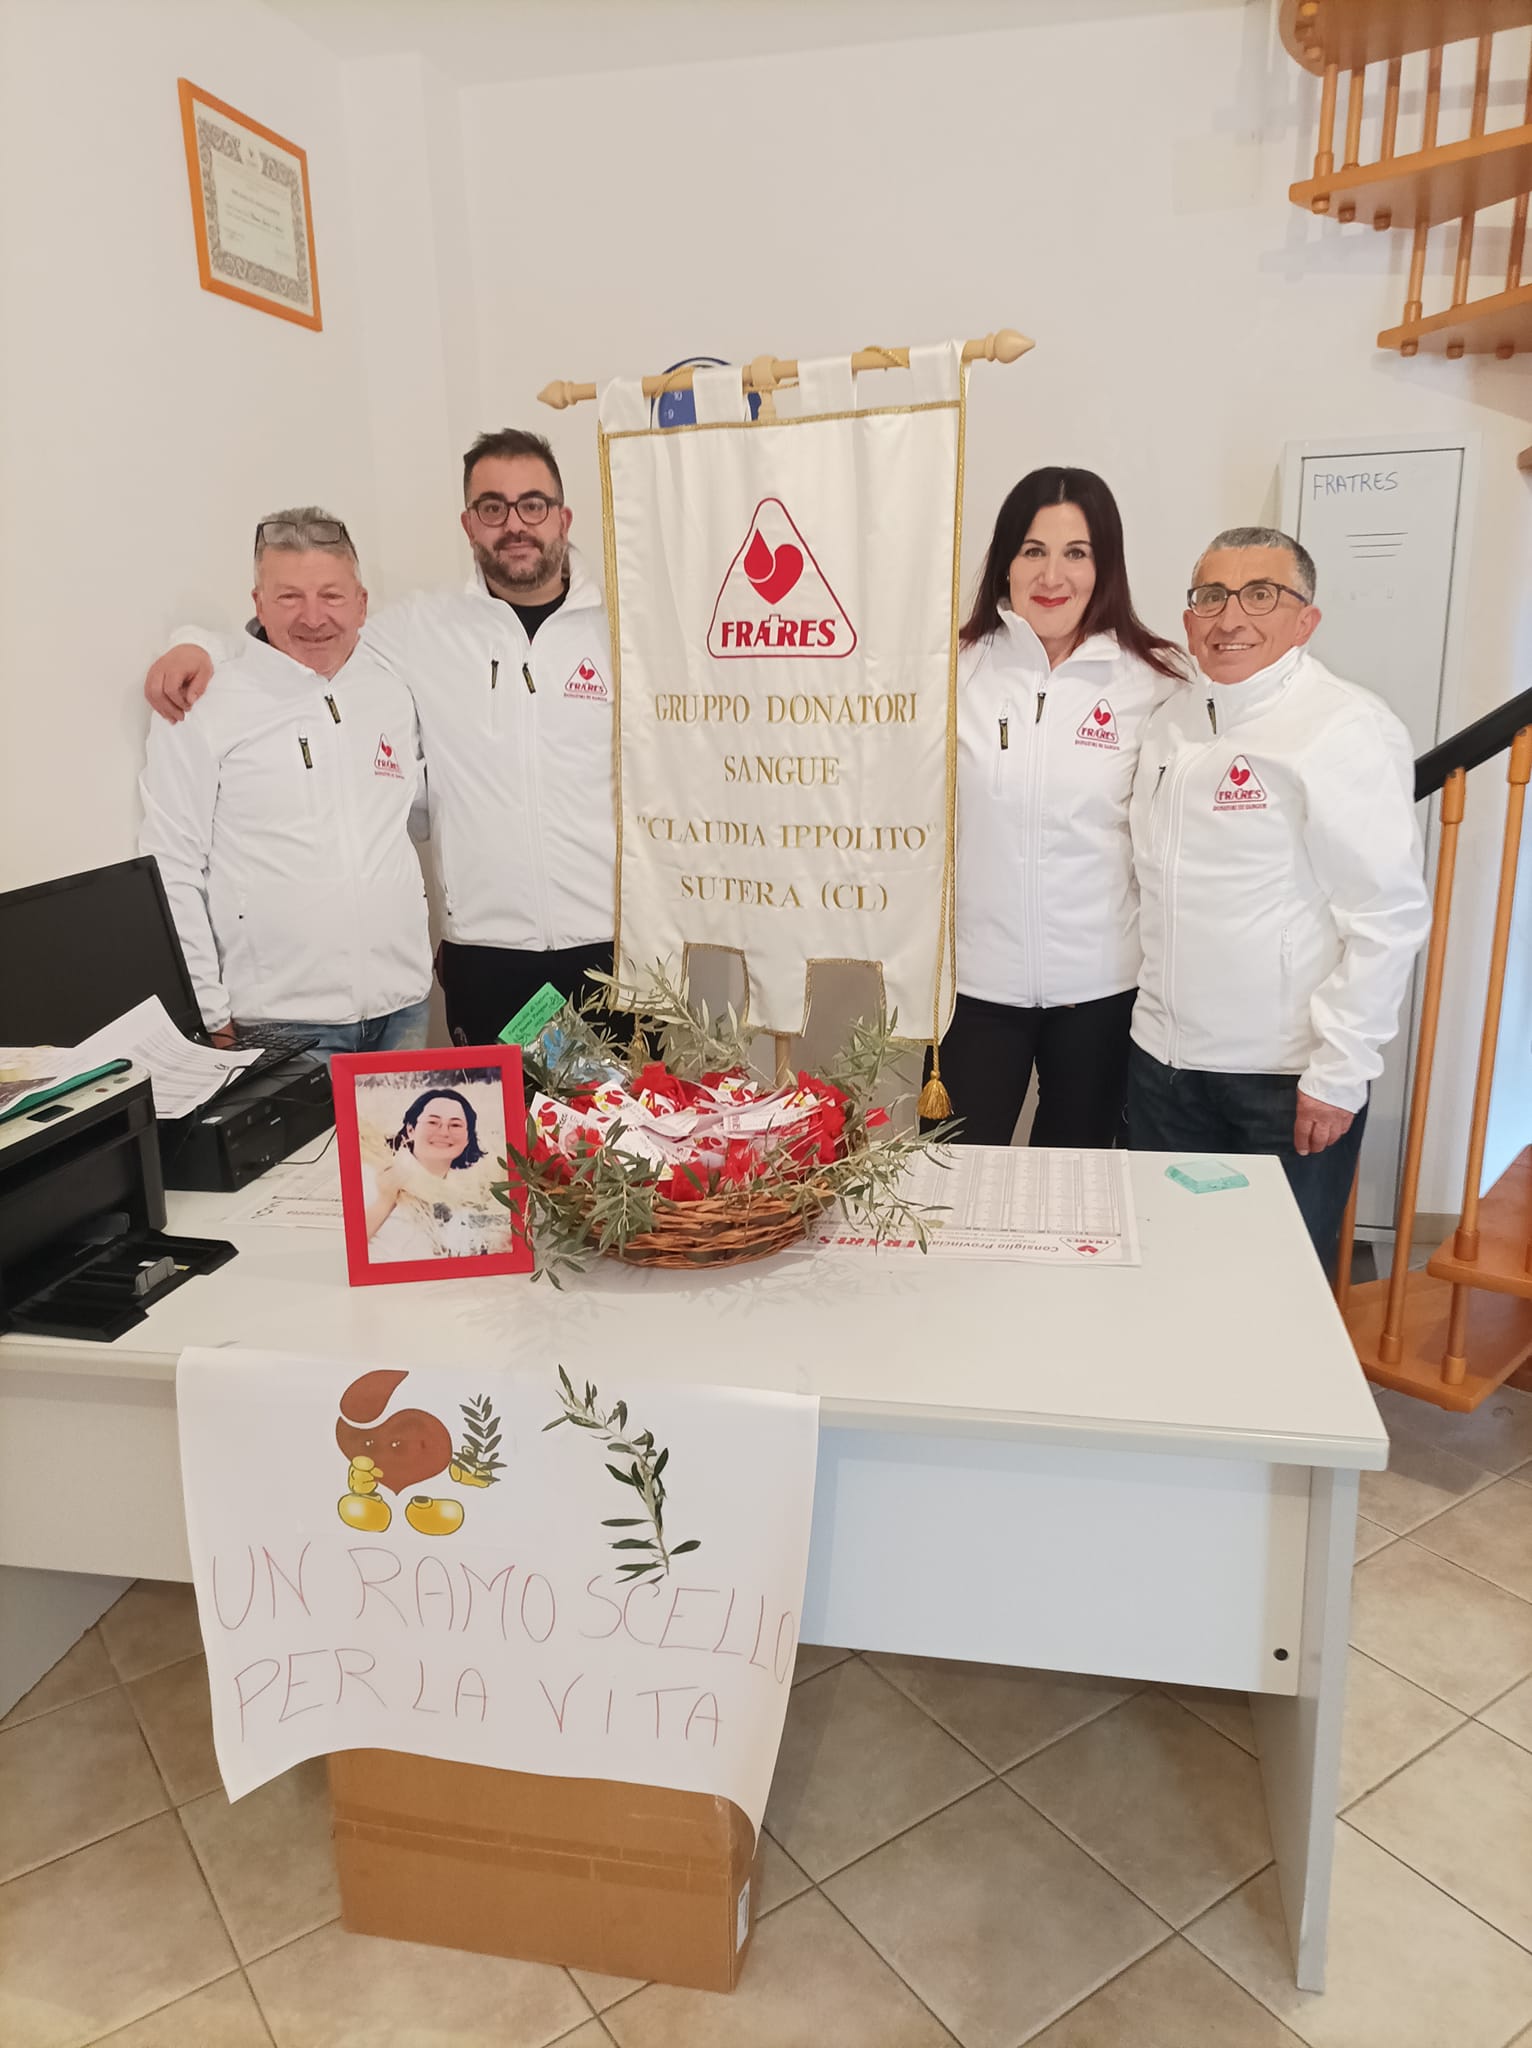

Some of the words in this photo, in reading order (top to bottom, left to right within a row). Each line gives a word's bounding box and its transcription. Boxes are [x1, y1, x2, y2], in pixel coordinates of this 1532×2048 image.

[1313, 471, 1399, 501] FRATRES
[721, 614, 836, 648] FRATRES
[654, 693, 751, 724] GRUPPO
[766, 692, 918, 725] DONATORI
[723, 754, 840, 786] SANGUE
[680, 874, 804, 908] SUTERA
[820, 880, 889, 913] (CL)
[921, 1239, 994, 1249] Provincial
[997, 1242, 1059, 1253] Consiglio
[212, 1541, 312, 1631] UN
[233, 1647, 387, 1743] PER
[412, 1659, 490, 1723] LA
[538, 1672, 724, 1748] VITA
